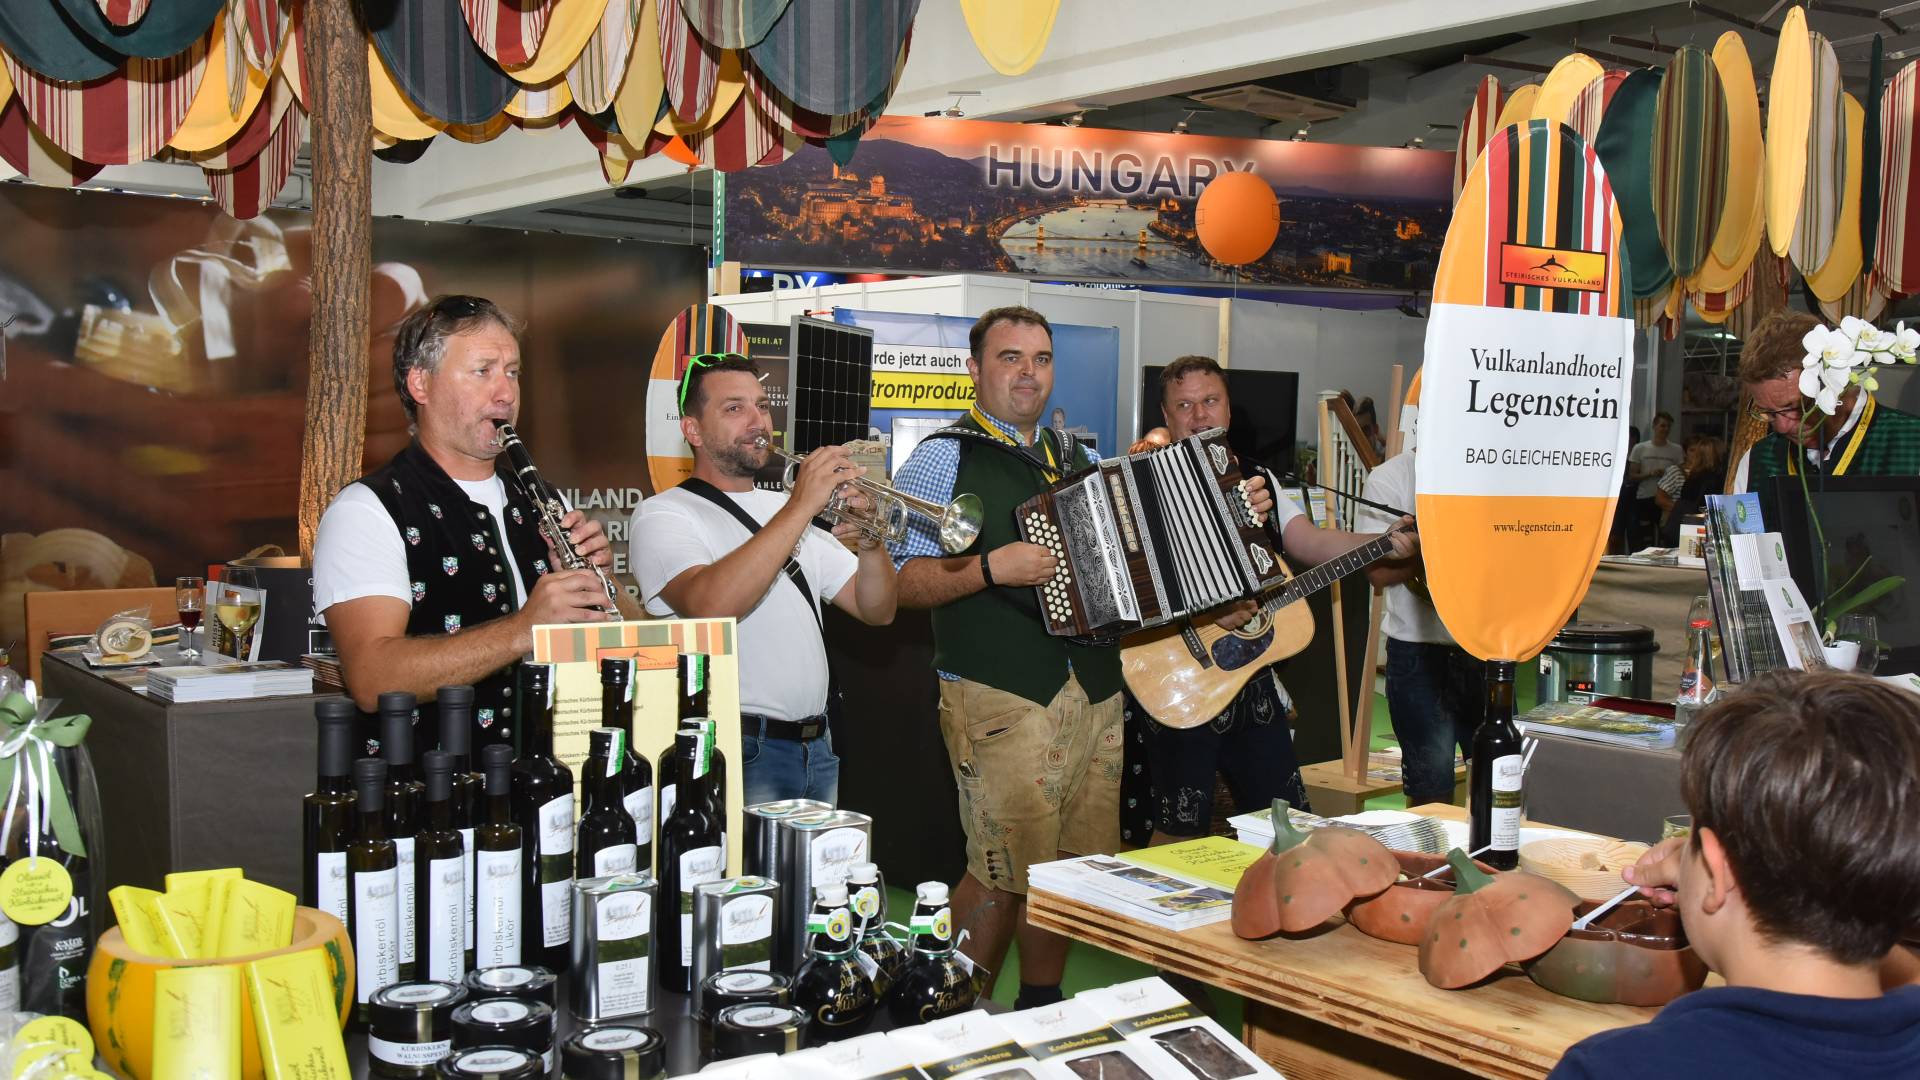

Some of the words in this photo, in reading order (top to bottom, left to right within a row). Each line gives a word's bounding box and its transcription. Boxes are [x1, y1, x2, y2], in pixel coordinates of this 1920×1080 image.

[1505, 272, 1549, 282] STEIRISCHES
[1553, 277, 1601, 286] VULKANLAND
[874, 352, 895, 365] rde
[899, 352, 926, 368] jetzt
[931, 355, 961, 367] auch
[1470, 348, 1622, 378] Vulkanlandhotel
[871, 380, 976, 404] tromproduz
[1466, 379, 1618, 427] Legenstein
[1466, 448, 1497, 464] BAD
[1502, 449, 1612, 467] GLEICHENBERG
[1493, 520, 1573, 533] www.legenstein.at
[404, 882, 414, 959] Kürbiskernöl
[505, 919, 514, 949] Likör
[376, 918, 387, 988] ürbiskernöl
[448, 903, 458, 982] Kürbiskernöl
